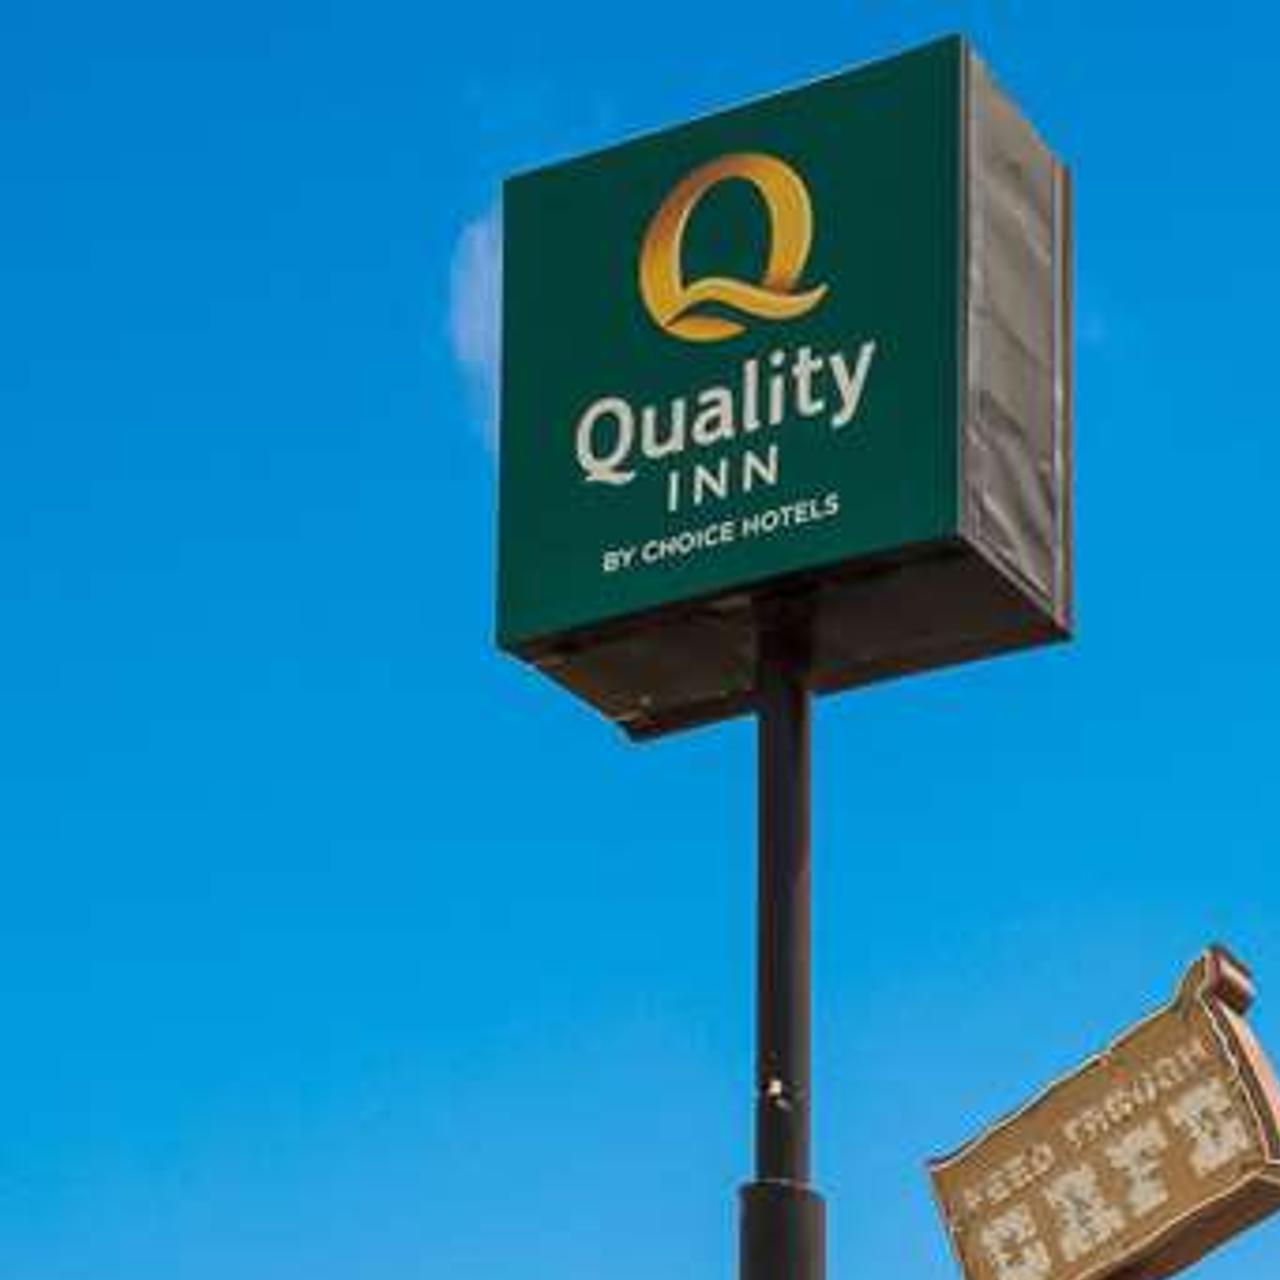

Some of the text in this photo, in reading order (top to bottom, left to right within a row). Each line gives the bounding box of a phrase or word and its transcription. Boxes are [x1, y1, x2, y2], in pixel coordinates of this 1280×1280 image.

[638, 152, 829, 341] Q
[575, 340, 876, 485] Quality
[603, 493, 840, 572] BY CHOICE HOTELS
[667, 445, 780, 512] INN
